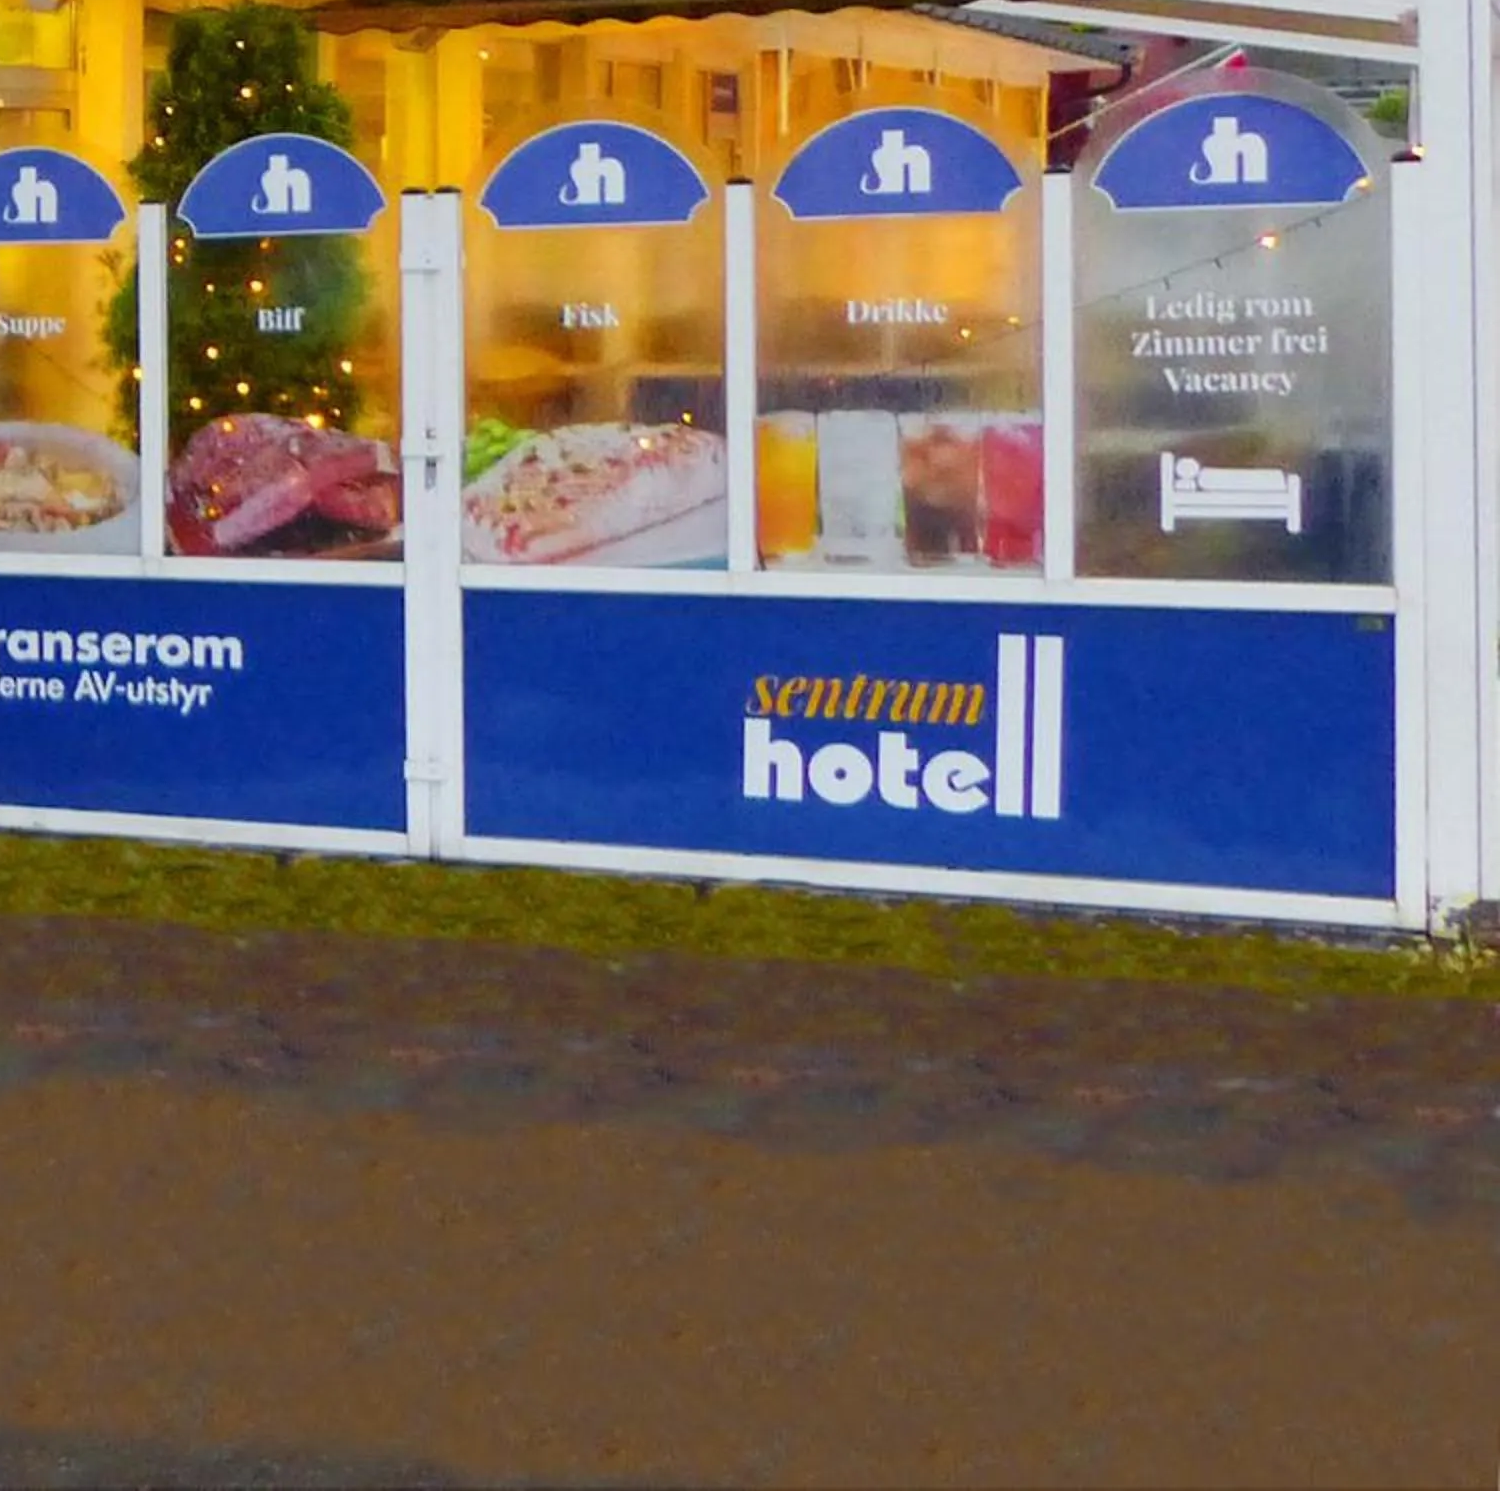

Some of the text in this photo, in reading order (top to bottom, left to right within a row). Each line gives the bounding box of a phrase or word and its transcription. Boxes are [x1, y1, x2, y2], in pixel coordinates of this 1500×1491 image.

[256, 305, 306, 333] Biff
[561, 301, 620, 329] Fisk
[845, 298, 949, 326] Drikke
[1145, 291, 1315, 324] Ledig rom
[1131, 325, 1329, 358] Zimmer frei
[1163, 366, 1298, 397] Vacancy
[73, 669, 212, 716] AV-utstyr
[744, 673, 986, 726] sentrum
[742, 631, 1065, 820] hotell
